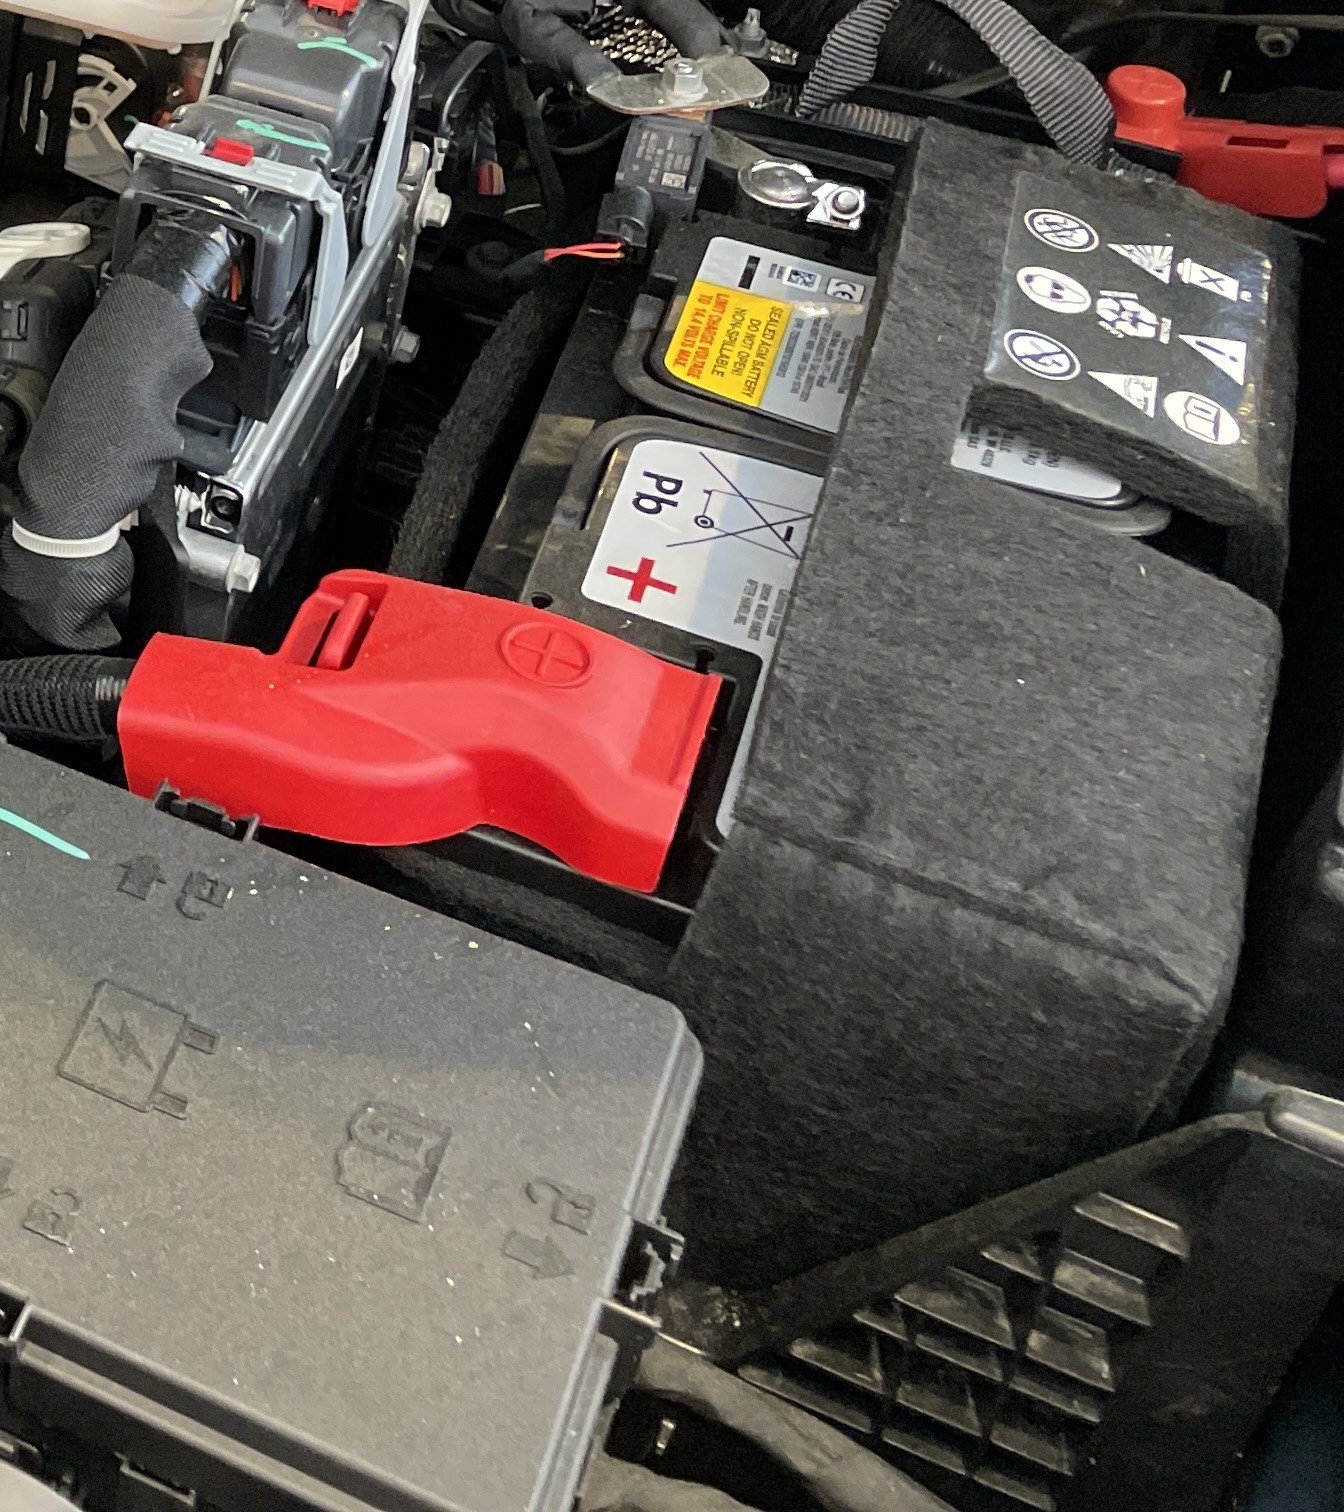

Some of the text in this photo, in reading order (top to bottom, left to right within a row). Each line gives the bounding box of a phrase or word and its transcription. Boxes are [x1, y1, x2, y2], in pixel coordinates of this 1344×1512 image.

[762, 306, 784, 340] SEALED
[742, 359, 765, 398] BATTERY
[632, 470, 684, 515] Pb
